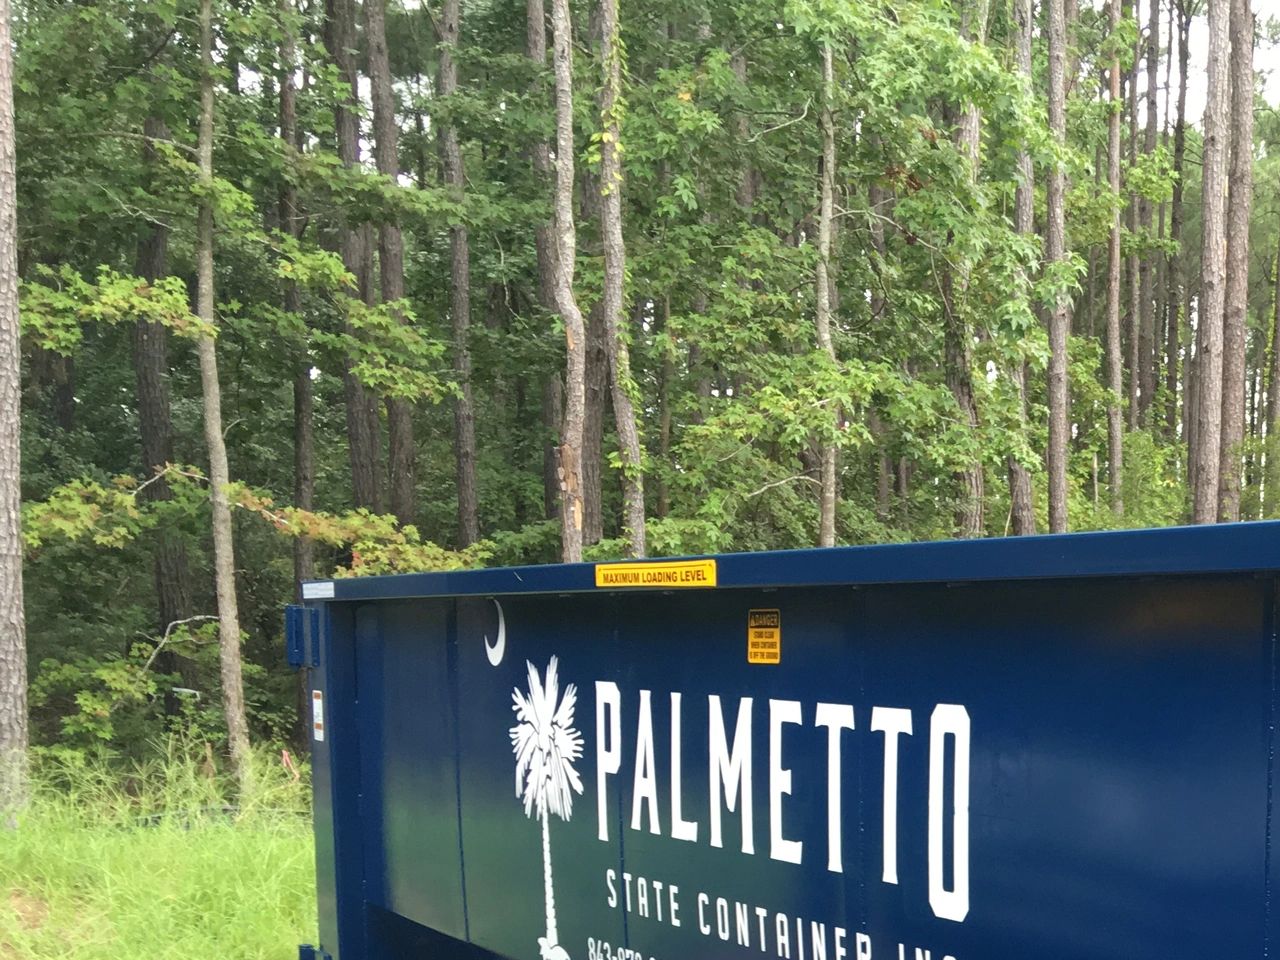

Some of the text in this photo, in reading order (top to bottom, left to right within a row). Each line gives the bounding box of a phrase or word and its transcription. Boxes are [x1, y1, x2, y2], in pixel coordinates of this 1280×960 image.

[602, 569, 707, 584] MAXIMUM LOADING LEVEL
[755, 614, 778, 626] DANGER
[595, 680, 971, 923] PALMETTO
[606, 868, 681, 928] STATE
